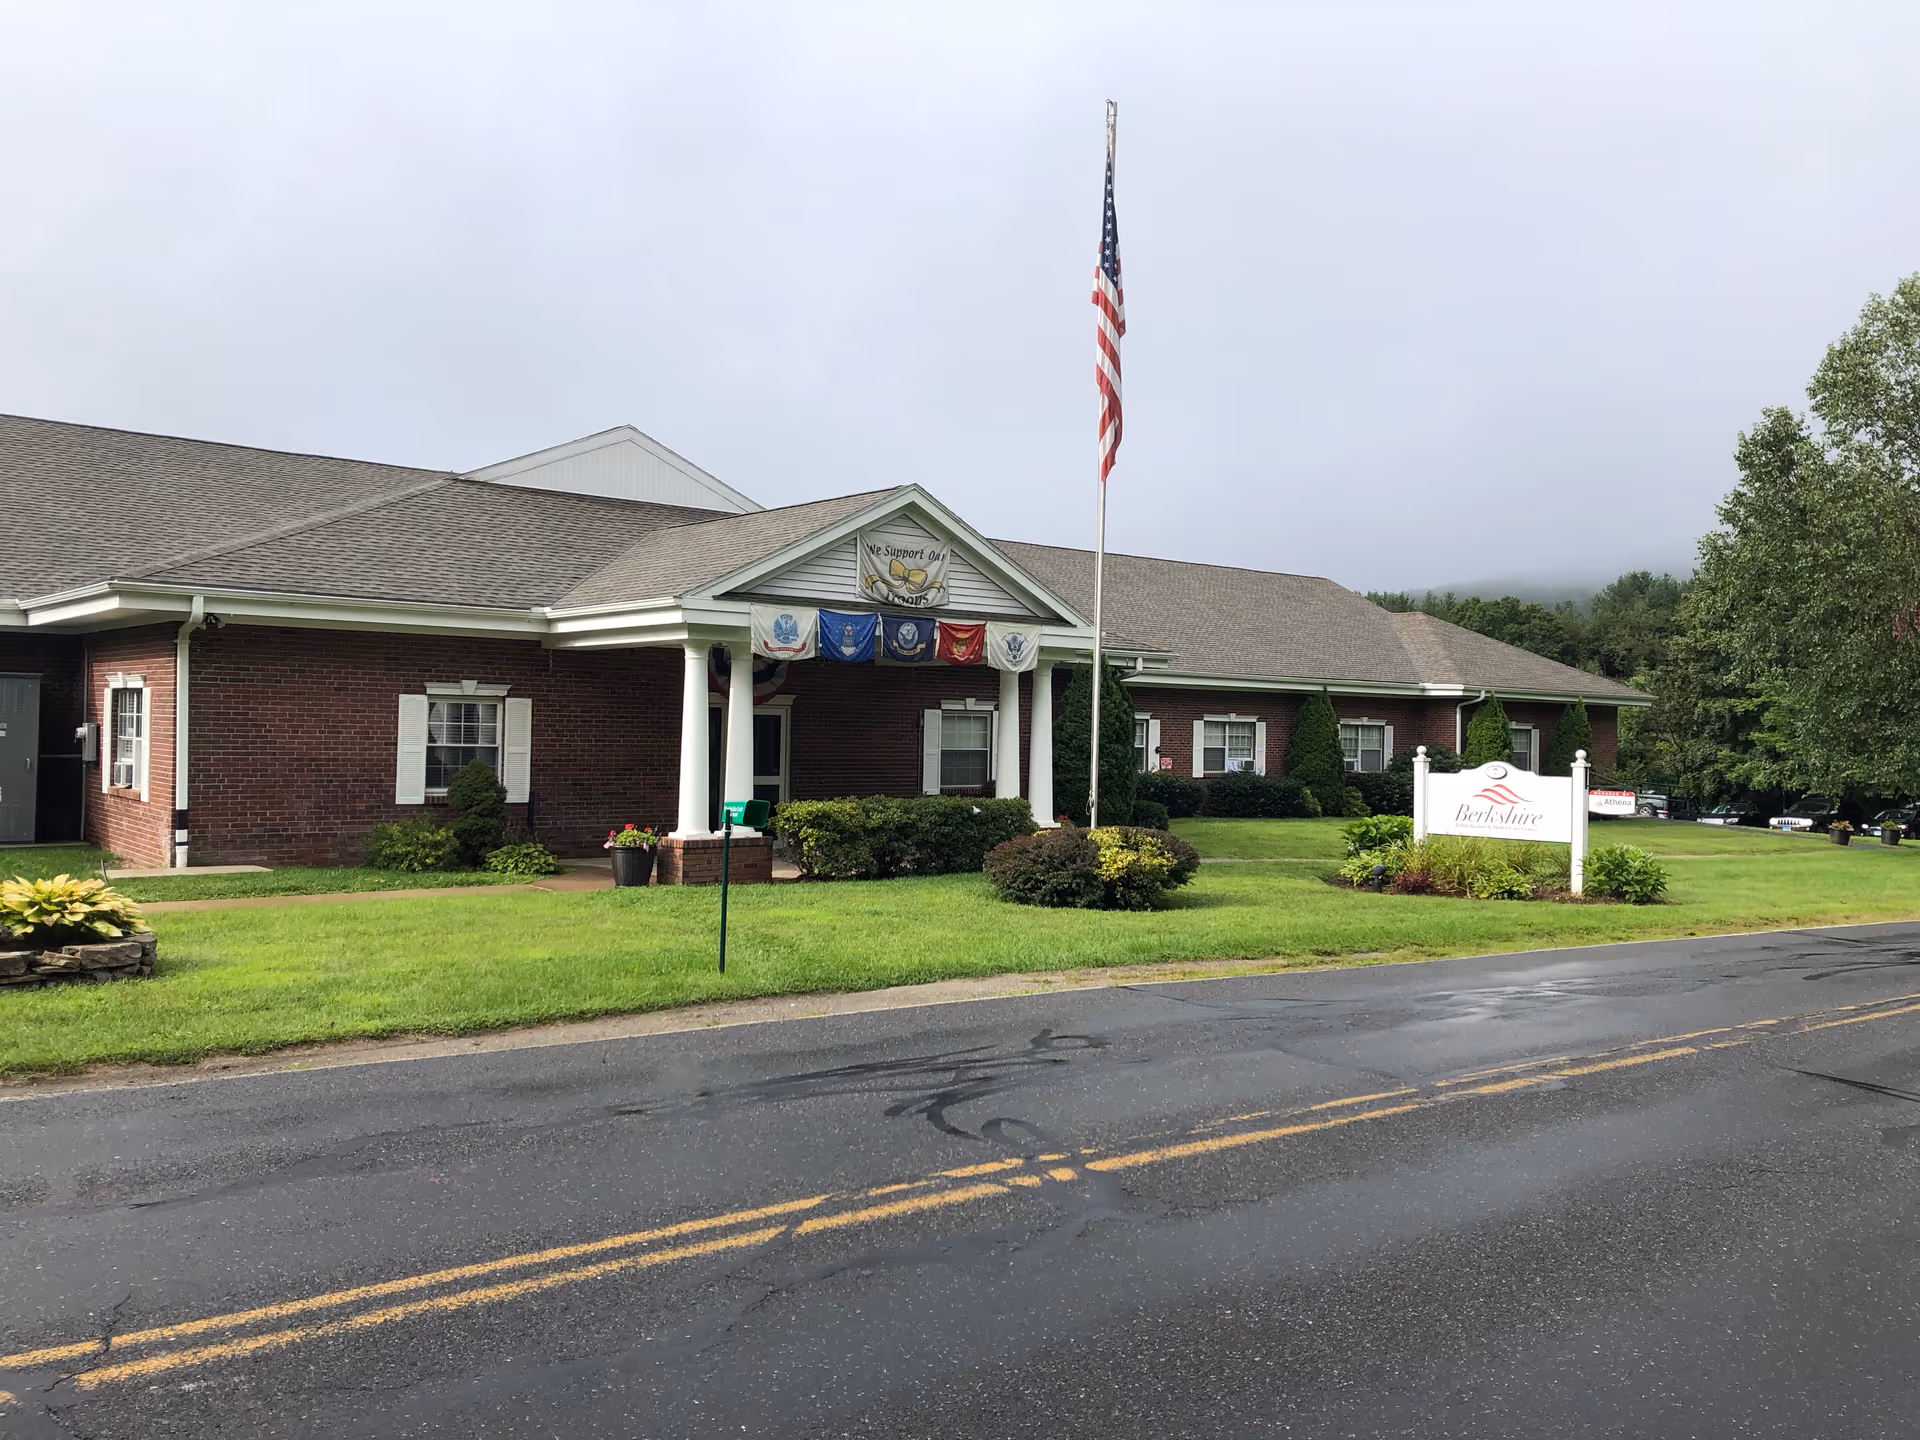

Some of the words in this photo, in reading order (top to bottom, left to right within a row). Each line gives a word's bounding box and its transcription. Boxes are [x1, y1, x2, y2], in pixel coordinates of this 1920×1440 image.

[884, 545, 925, 560] Support
[1604, 798, 1632, 806] Athena
[1455, 803, 1543, 826] Berkshire
